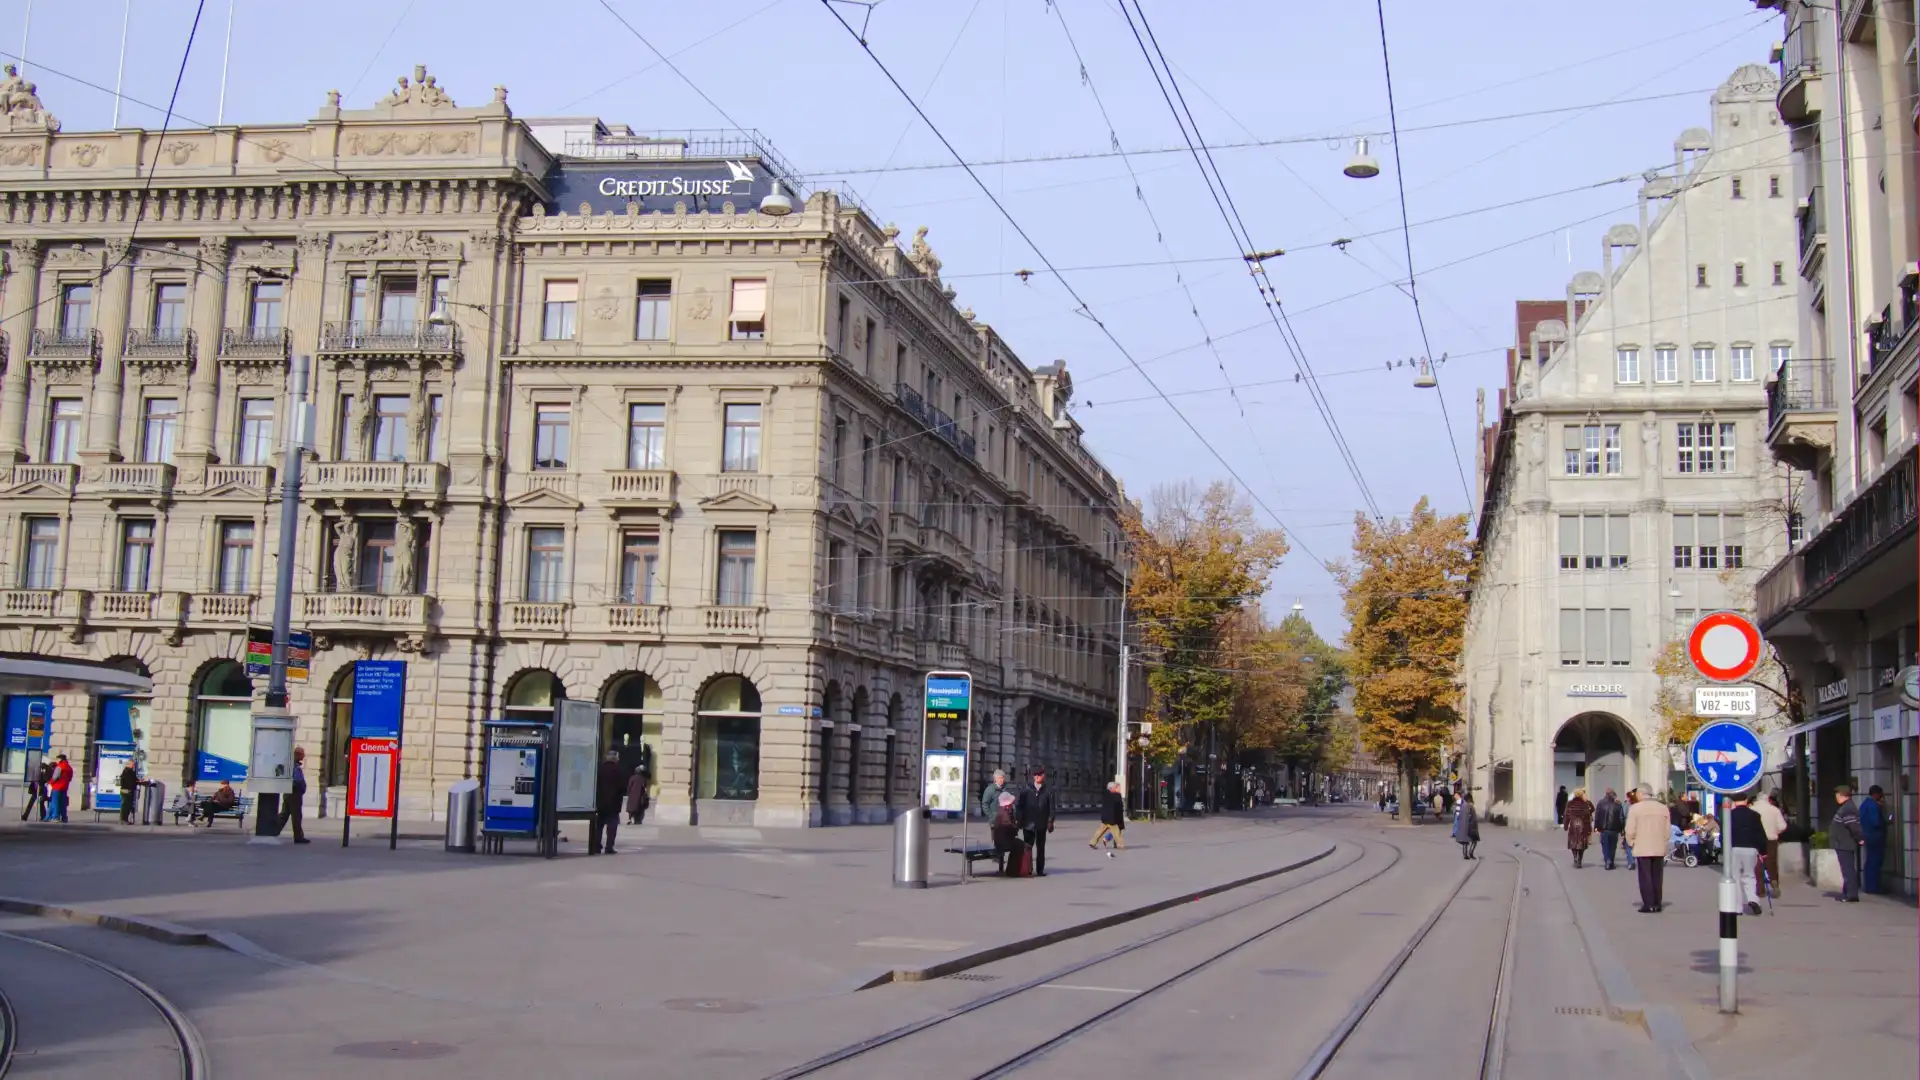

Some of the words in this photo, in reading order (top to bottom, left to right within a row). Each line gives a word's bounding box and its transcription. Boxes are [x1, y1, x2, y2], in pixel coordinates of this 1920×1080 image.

[599, 177, 668, 196] CREDIT
[671, 176, 732, 195] SUISSE
[1570, 683, 1623, 694] GRIEDER
[1818, 679, 1848, 704] MARSANO
[1701, 700, 1721, 711] VBZ
[1731, 700, 1751, 711] BUS
[360, 743, 389, 752] Cinema
